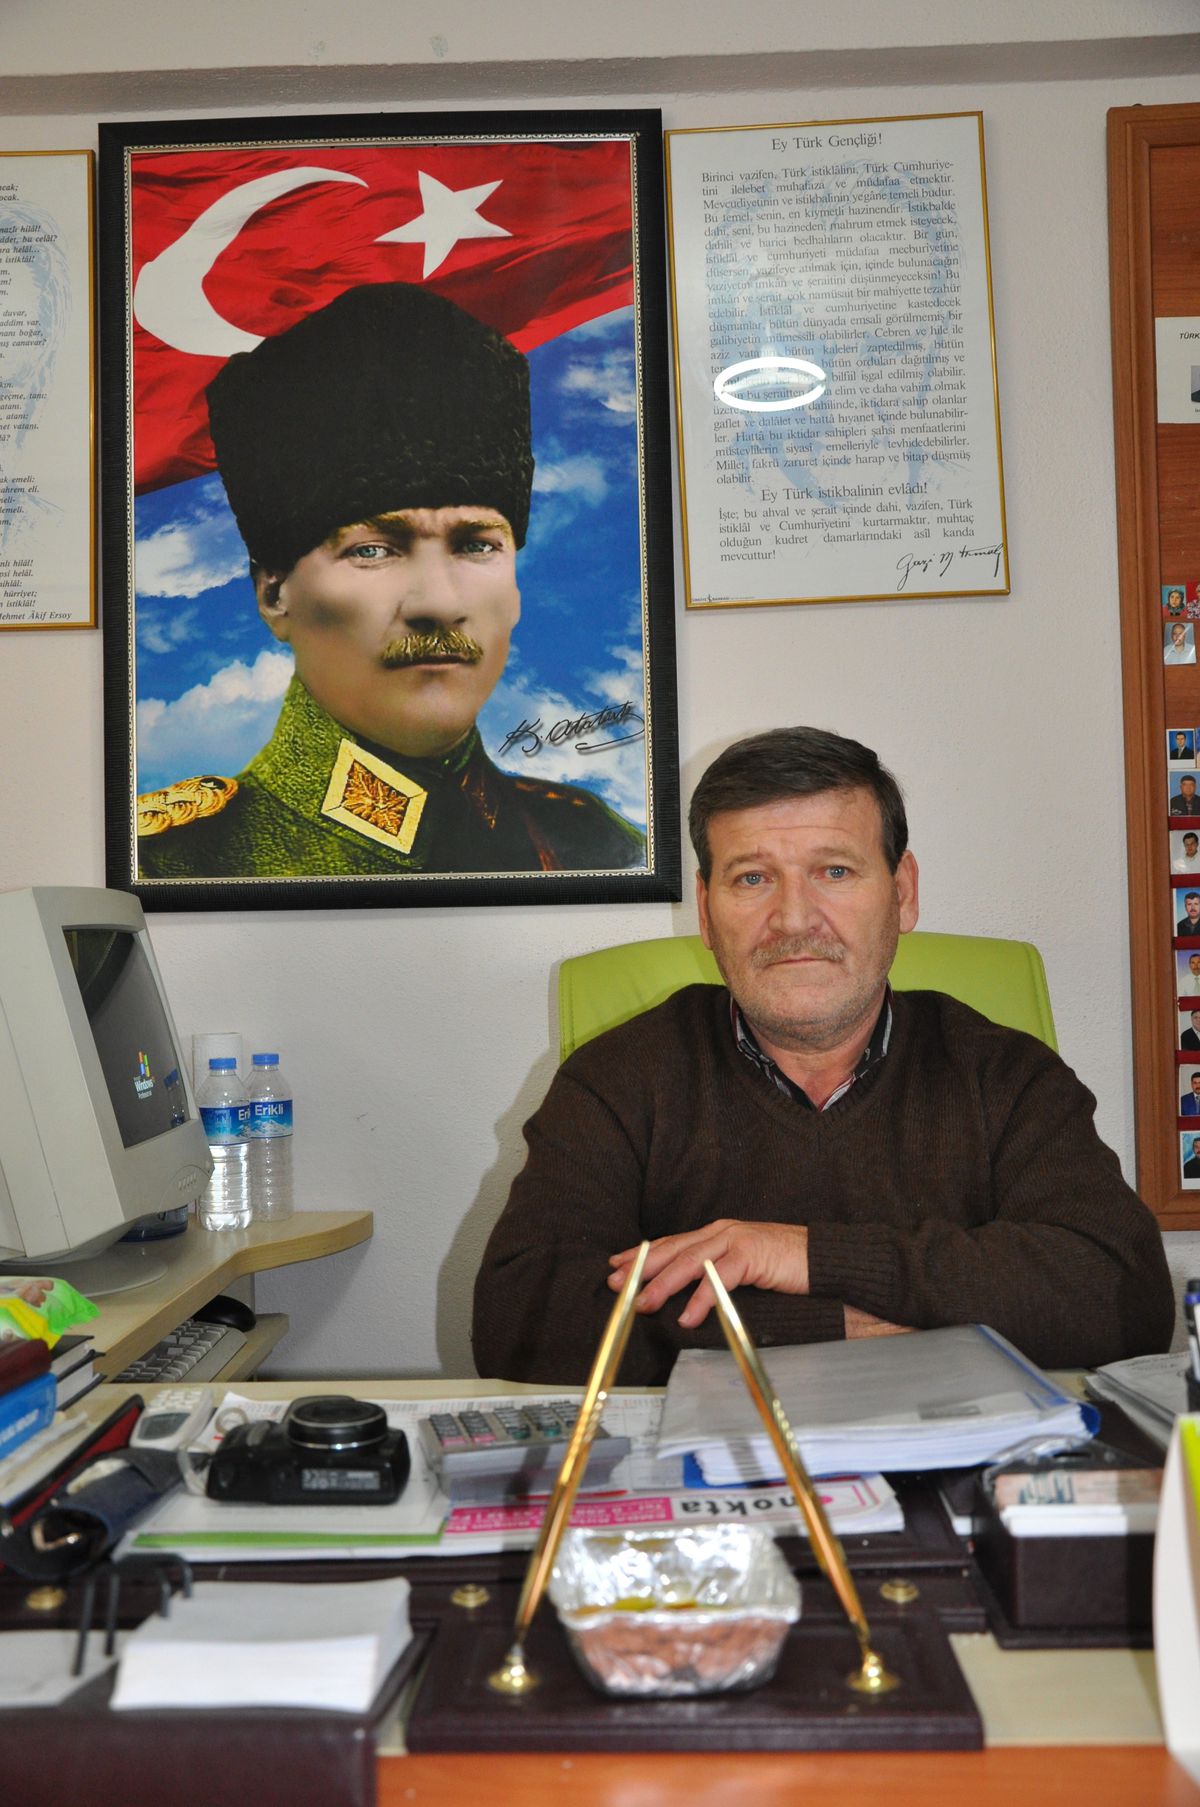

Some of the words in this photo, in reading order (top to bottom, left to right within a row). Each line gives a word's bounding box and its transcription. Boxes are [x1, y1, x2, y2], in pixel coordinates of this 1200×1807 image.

[772, 138, 788, 152] Ey
[793, 136, 823, 149] Türk
[828, 133, 882, 148] Gençliği!
[702, 171, 734, 182] Birinci
[781, 167, 807, 179] Türk
[865, 162, 889, 174] Türk
[894, 159, 954, 172] Cumhuriye-
[702, 185, 718, 196] tini
[731, 184, 765, 195] ilelebet
[777, 181, 825, 192] muhafaza
[835, 180, 847, 189] ve
[856, 176, 900, 188] müdafaa
[910, 173, 955, 185] etmektir.
[703, 198, 779, 211] Mevcudiyetinin
[782, 197, 793, 205] ve
[795, 192, 850, 205] istikbalinin
[852, 190, 887, 204] yegâne
[889, 188, 919, 200] temeli
[921, 187, 956, 198] budur.
[704, 213, 718, 223] Bu
[788, 210, 800, 219] en
[805, 205, 844, 219] kıymetli
[848, 203, 903, 216] hazinendir.
[908, 200, 956, 213] İstikbalde
[758, 224, 770, 234] bu
[830, 219, 872, 231] mahrum
[876, 217, 907, 228] etmek
[22, 235, 33, 243] bu
[740, 240, 751, 249] ve
[860, 232, 906, 243] olacaktır.
[914, 229, 928, 240] Bir
[935, 230, 958, 241] gün,
[747, 254, 758, 262] ve
[767, 248, 826, 261] cumhuriyeti
[836, 246, 880, 258] müdafaa
[889, 242, 959, 256] mecburiyetine
[865, 259, 894, 271] içinde
[898, 256, 959, 268] bulunacağın
[792, 279, 803, 287] ve
[945, 269, 960, 280] Bu
[743, 296, 754, 304] ve
[857, 287, 871, 297] bir
[873, 285, 921, 297] mahiyette
[924, 284, 961, 294] tezahür
[804, 305, 815, 313] ve
[825, 300, 897, 314] cumhuriyetine
[908, 297, 961, 309] kastedecek
[769, 319, 799, 329] bütün
[802, 317, 846, 329] dünyada
[850, 314, 882, 325] emsali
[886, 311, 945, 325] görülmemiş
[948, 310, 963, 321] bir
[875, 327, 910, 338] Cebren
[915, 328, 927, 336] ve
[930, 325, 948, 335] hile
[952, 324, 964, 334] ile
[711, 350, 730, 360] aziz
[784, 345, 814, 356] bütün
[934, 339, 964, 350] bütün
[821, 358, 851, 369] bütün
[856, 357, 896, 368] orduları
[900, 354, 949, 367] dağıtılmış
[831, 370, 856, 381] bilfiil
[861, 370, 883, 382] işgal
[887, 369, 923, 380] edilmiş
[927, 367, 966, 378] olabilir.
[747, 389, 760, 399] bu
[834, 386, 856, 396] elim
[859, 386, 870, 394] ve
[873, 384, 897, 394] daha
[900, 382, 931, 392] vahim
[934, 381, 966, 391] olmak
[860, 398, 899, 408] iktidara
[902, 396, 928, 407] sahip
[932, 395, 967, 405] olanlar
[713, 418, 740, 431] gaflet
[745, 420, 754, 428] ve
[795, 417, 806, 425] ve
[838, 413, 874, 424] hıyanet
[878, 411, 907, 422] içinde
[910, 408, 968, 420] bulunabilir-
[714, 432, 730, 443] ler.
[769, 430, 782, 440] bu
[787, 429, 820, 440] iktidar
[825, 426, 866, 438] sahipleri
[901, 421, 966, 434] menfaatlerini
[826, 440, 879, 452] emelleriyle
[752, 458, 779, 469] fakrü
[783, 458, 818, 467] zaruret
[822, 455, 851, 468] içinde
[856, 454, 885, 465] harap
[903, 452, 928, 463] bitap
[931, 450, 971, 462] düşmüş
[716, 474, 754, 484] olabilir.
[761, 489, 778, 503] Ey
[782, 487, 813, 500] Türk
[818, 483, 883, 498] istikbalinin
[888, 482, 928, 495] evlâdı!
[744, 508, 757, 518] bu
[762, 507, 790, 518] ahval
[795, 508, 806, 516] ve
[811, 505, 837, 517] şerait
[843, 503, 872, 515] içinde
[947, 499, 973, 510] Türk
[719, 522, 751, 534] istiklâl
[760, 523, 771, 531] ve
[779, 518, 851, 531] Cumhuriyetini
[936, 513, 974, 525] muhtaç
[719, 537, 762, 548] olduğun
[775, 535, 808, 545] kudret
[823, 529, 902, 543] damarlarındaki
[943, 527, 975, 538] kanda
[721, 550, 776, 562] mevcuttur!
[0, 612, 25, 620] ehmet
[49, 611, 72, 620] Ersoy
[254, 1102, 284, 1116] Erikli
[680, 1496, 798, 1516] nokta
